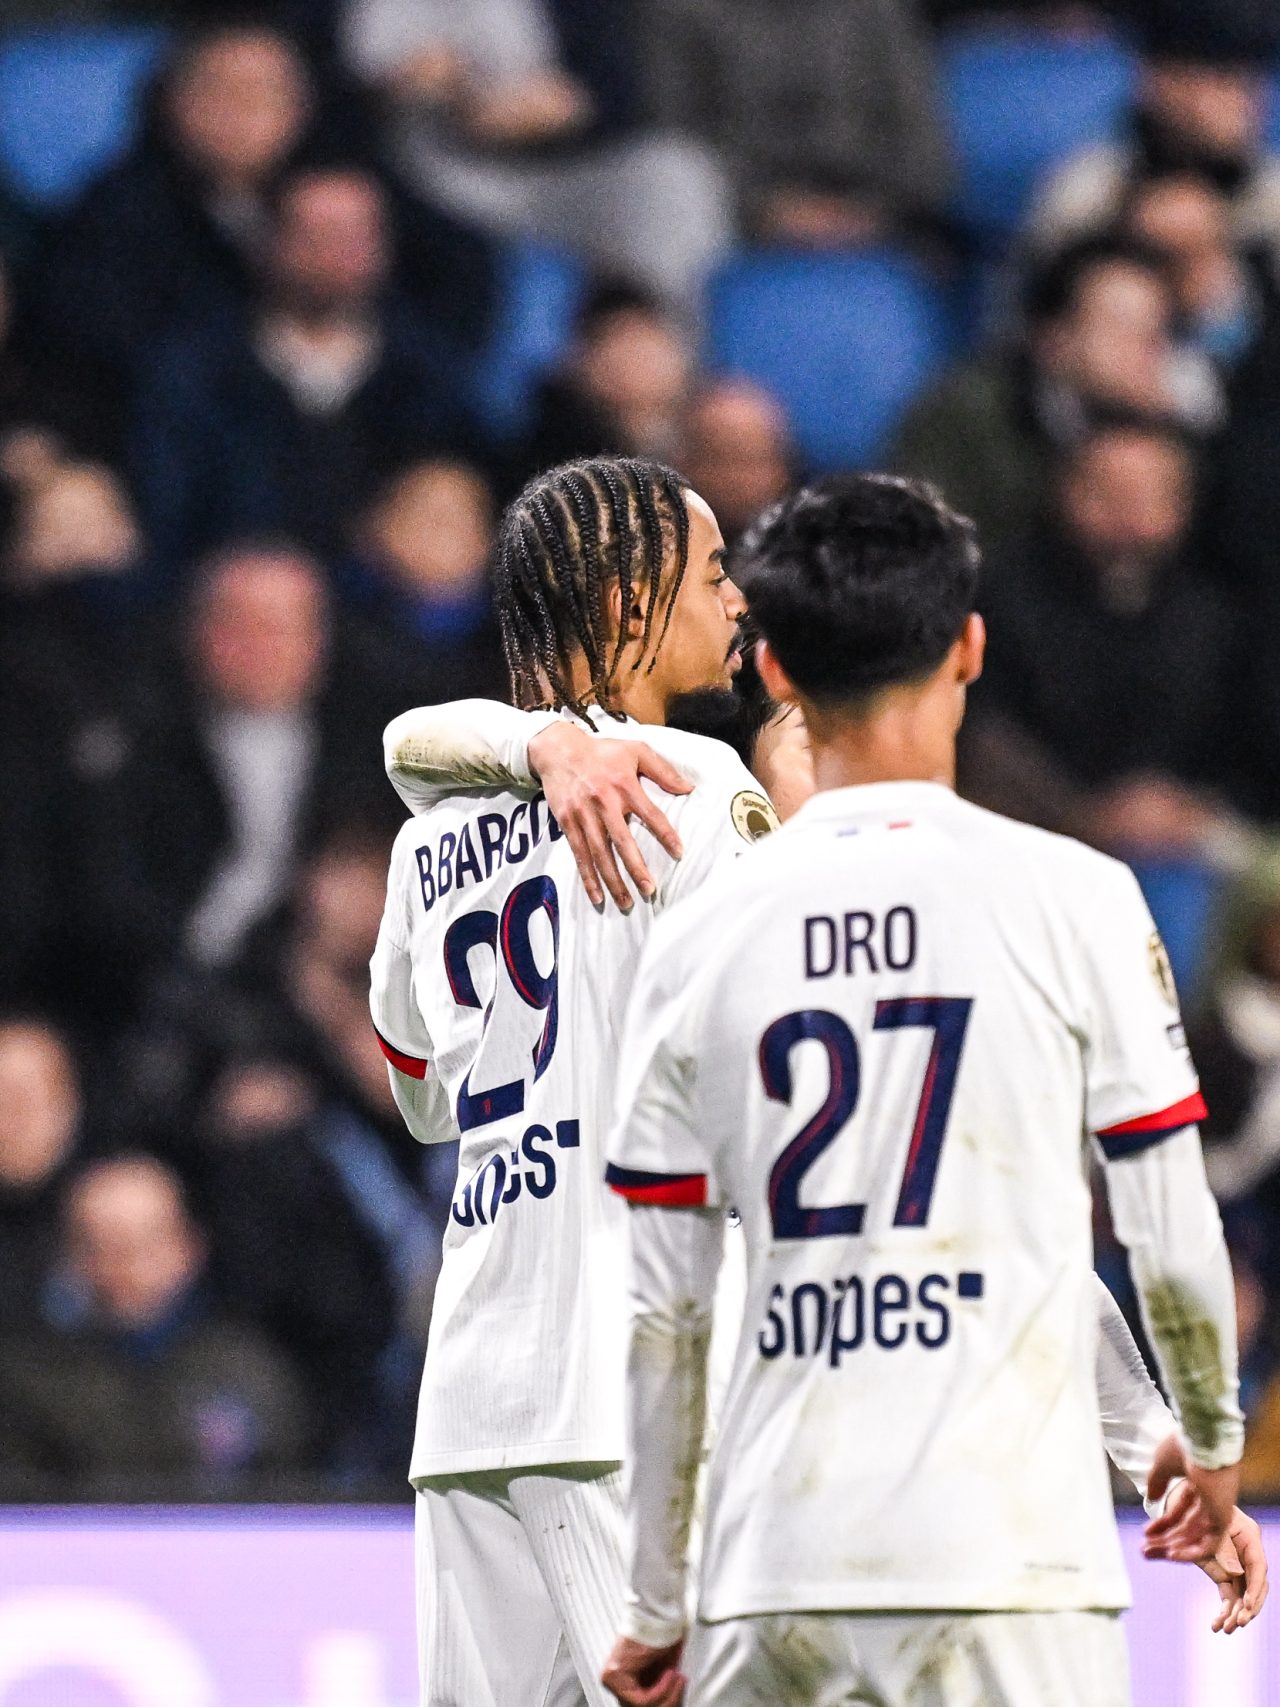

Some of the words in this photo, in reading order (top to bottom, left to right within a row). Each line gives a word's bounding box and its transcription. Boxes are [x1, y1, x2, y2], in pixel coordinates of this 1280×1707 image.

[443, 874, 560, 1134] 29
[804, 905, 917, 980] DRO
[758, 996, 975, 1240] 27
